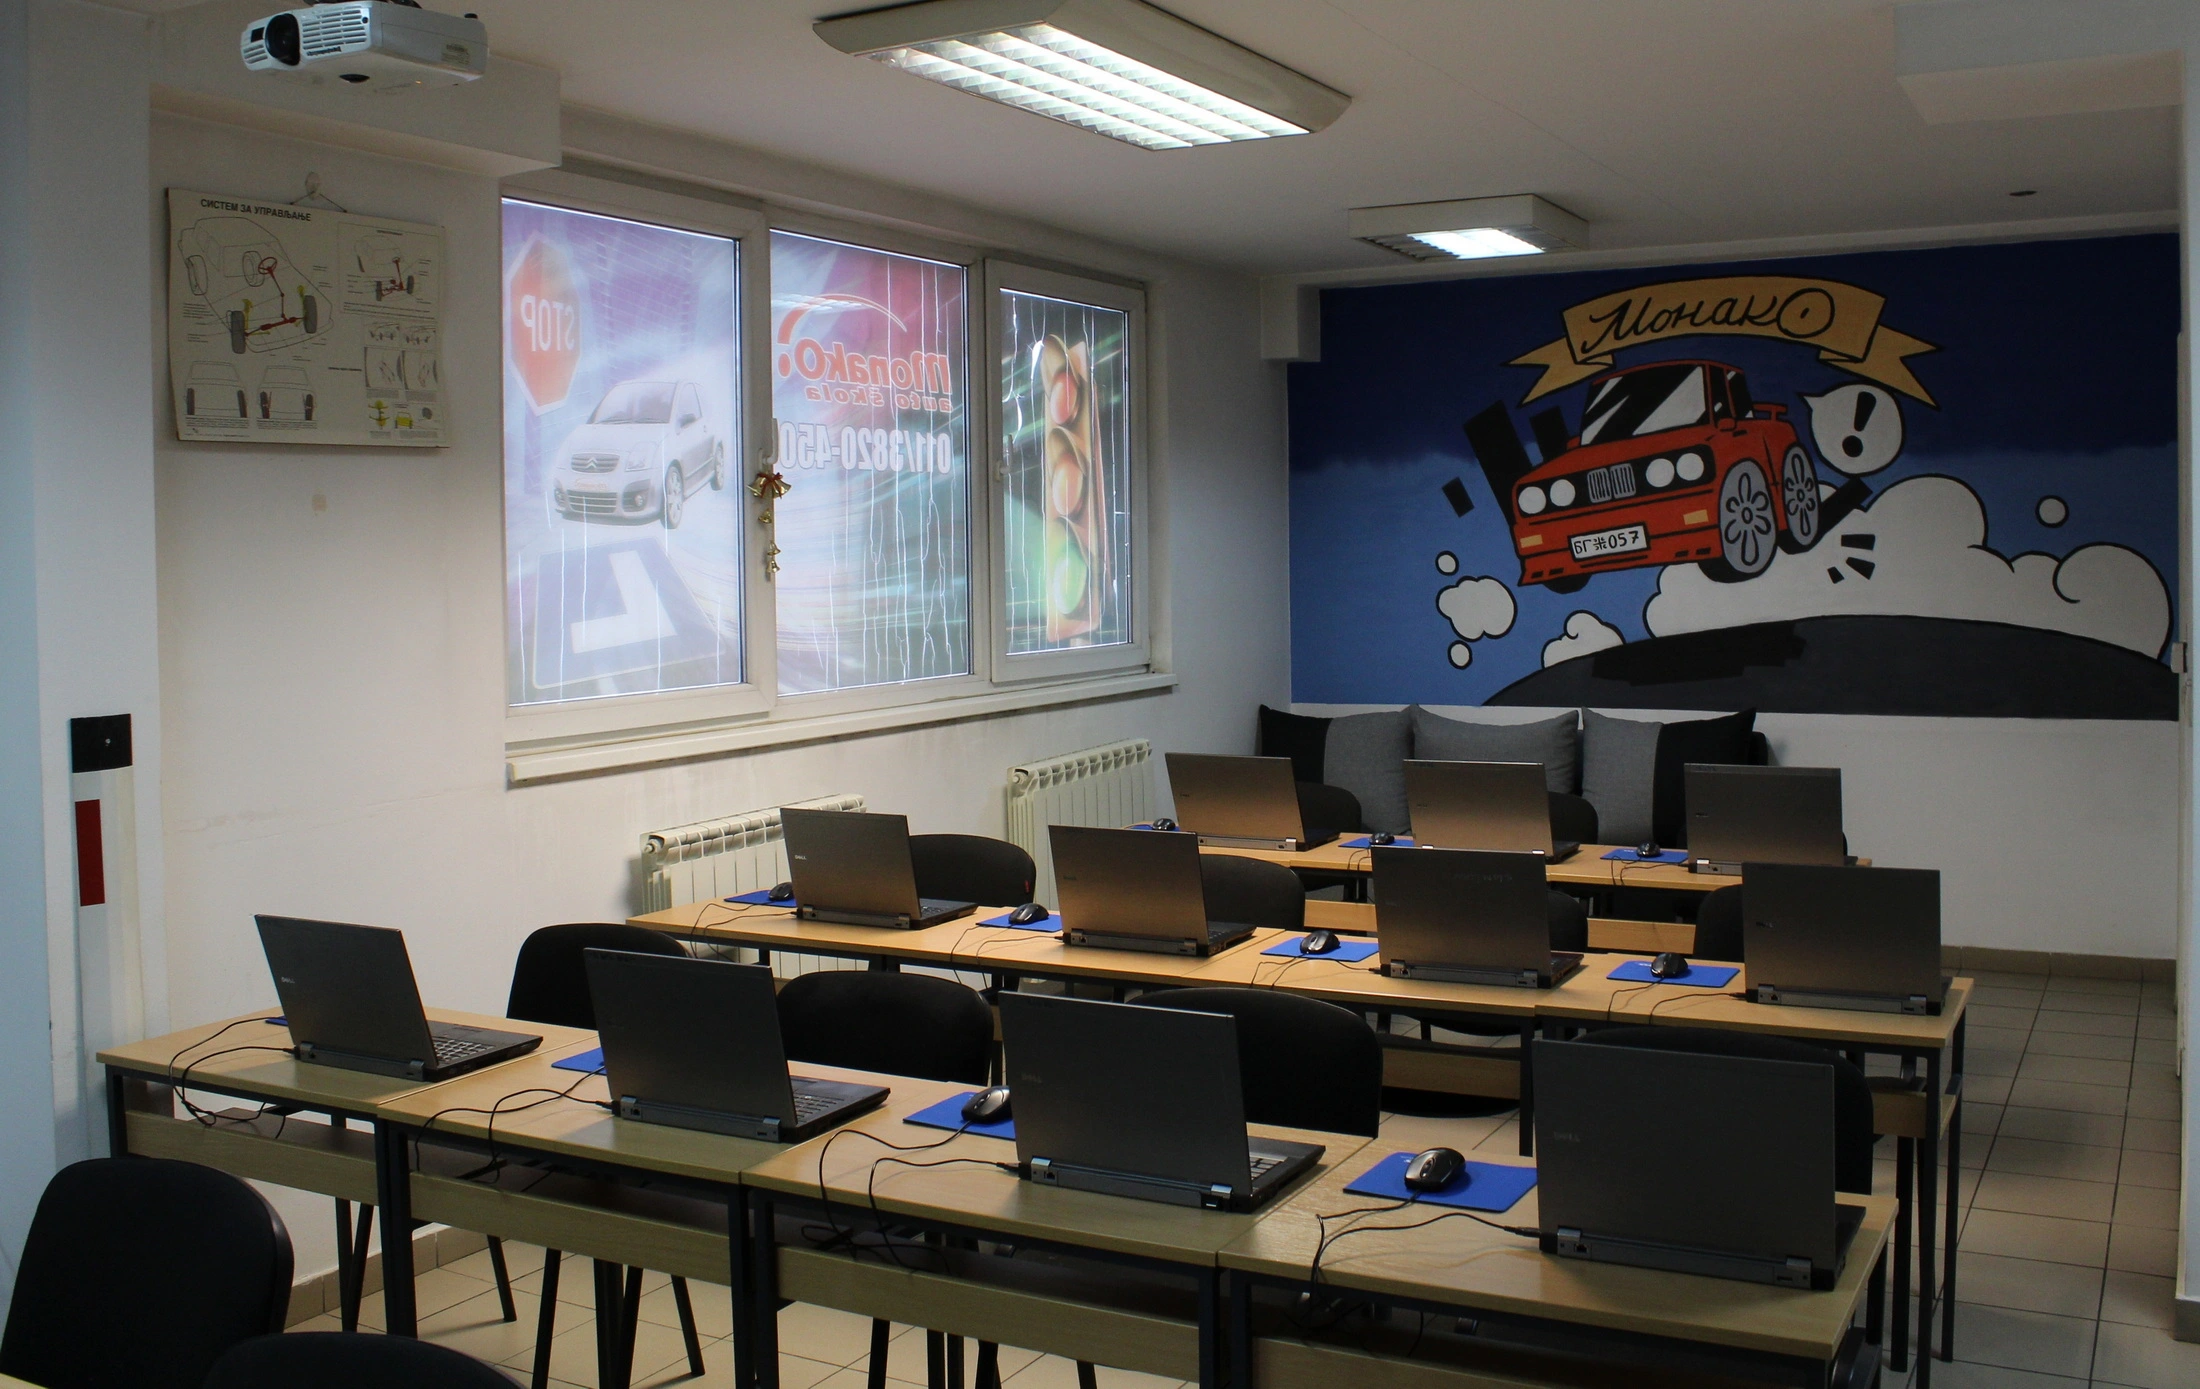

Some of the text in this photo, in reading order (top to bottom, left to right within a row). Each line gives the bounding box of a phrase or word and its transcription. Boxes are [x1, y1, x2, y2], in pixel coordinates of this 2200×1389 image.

[200, 199, 311, 221] СИСТЕМ ЗА УПРАВЉАЊЕ
